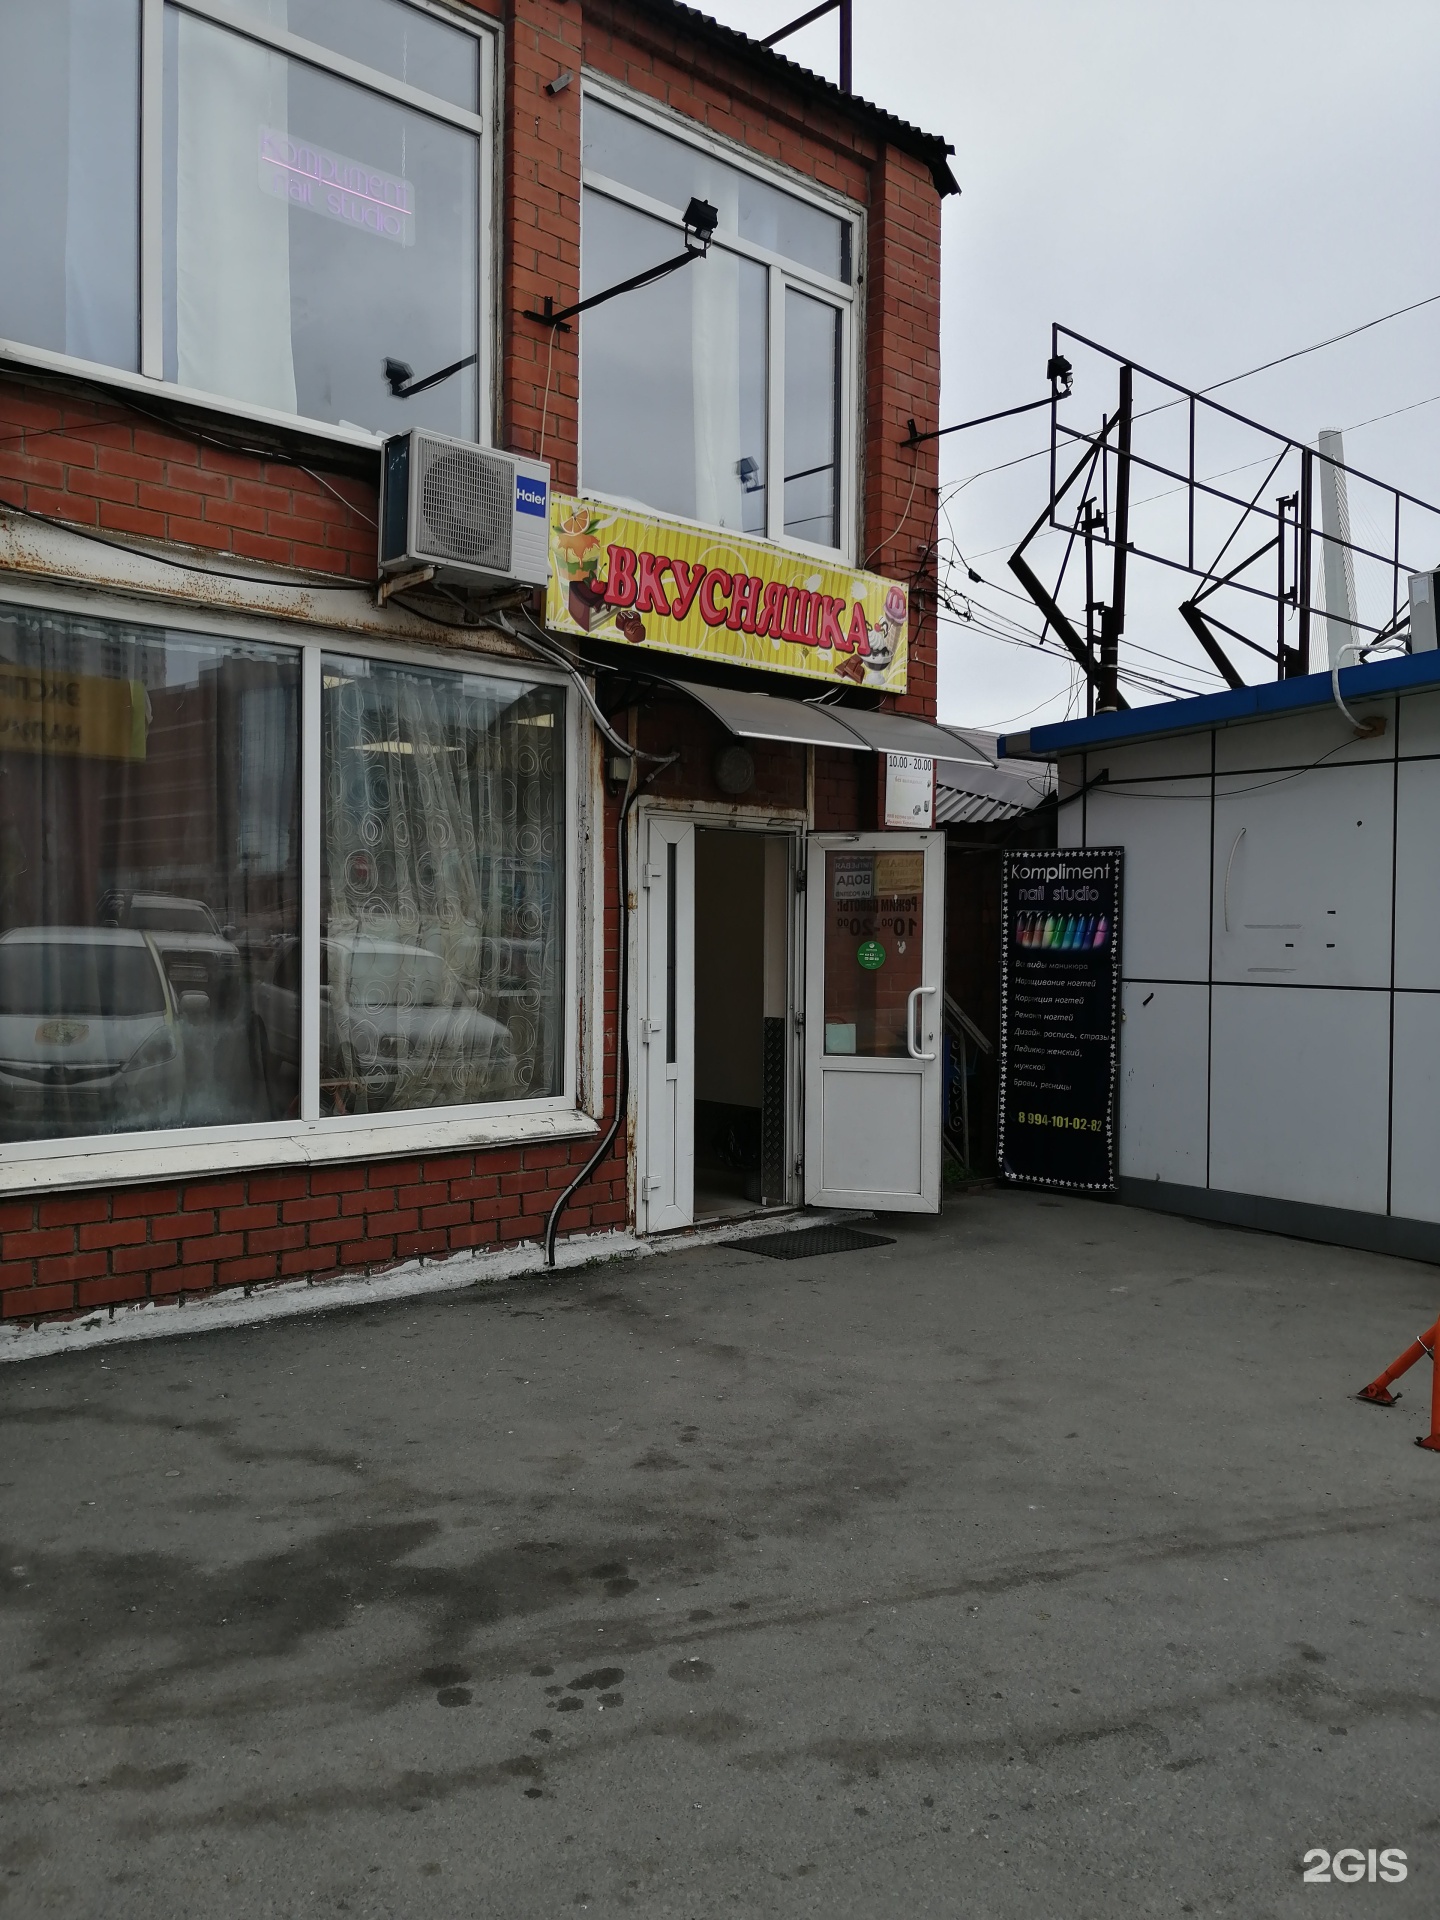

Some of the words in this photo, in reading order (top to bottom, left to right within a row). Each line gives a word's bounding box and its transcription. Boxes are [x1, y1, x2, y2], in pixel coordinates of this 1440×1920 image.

[327, 190, 401, 235] studio
[516, 488, 546, 506] Haier
[604, 544, 871, 656] ВКУСНЯШКА
[888, 755, 908, 770] 10.00
[913, 758, 932, 772] 20.00
[1011, 863, 1110, 880] Kompliment
[1018, 885, 1045, 901] nail
[1052, 886, 1099, 902] studio
[1048, 963, 1089, 971] маникюра
[1066, 979, 1096, 988] ногтей
[1054, 996, 1085, 1005] ногтей
[1043, 1013, 1074, 1021] ногтей
[1079, 1033, 1110, 1042] стразы
[1046, 1048, 1083, 1058] женский,
[1013, 1063, 1046, 1071] мужской
[1039, 1082, 1072, 1092] ресницы
[1018, 1111, 1026, 1124] 8
[1027, 1112, 1103, 1132] 994-101-02-82
